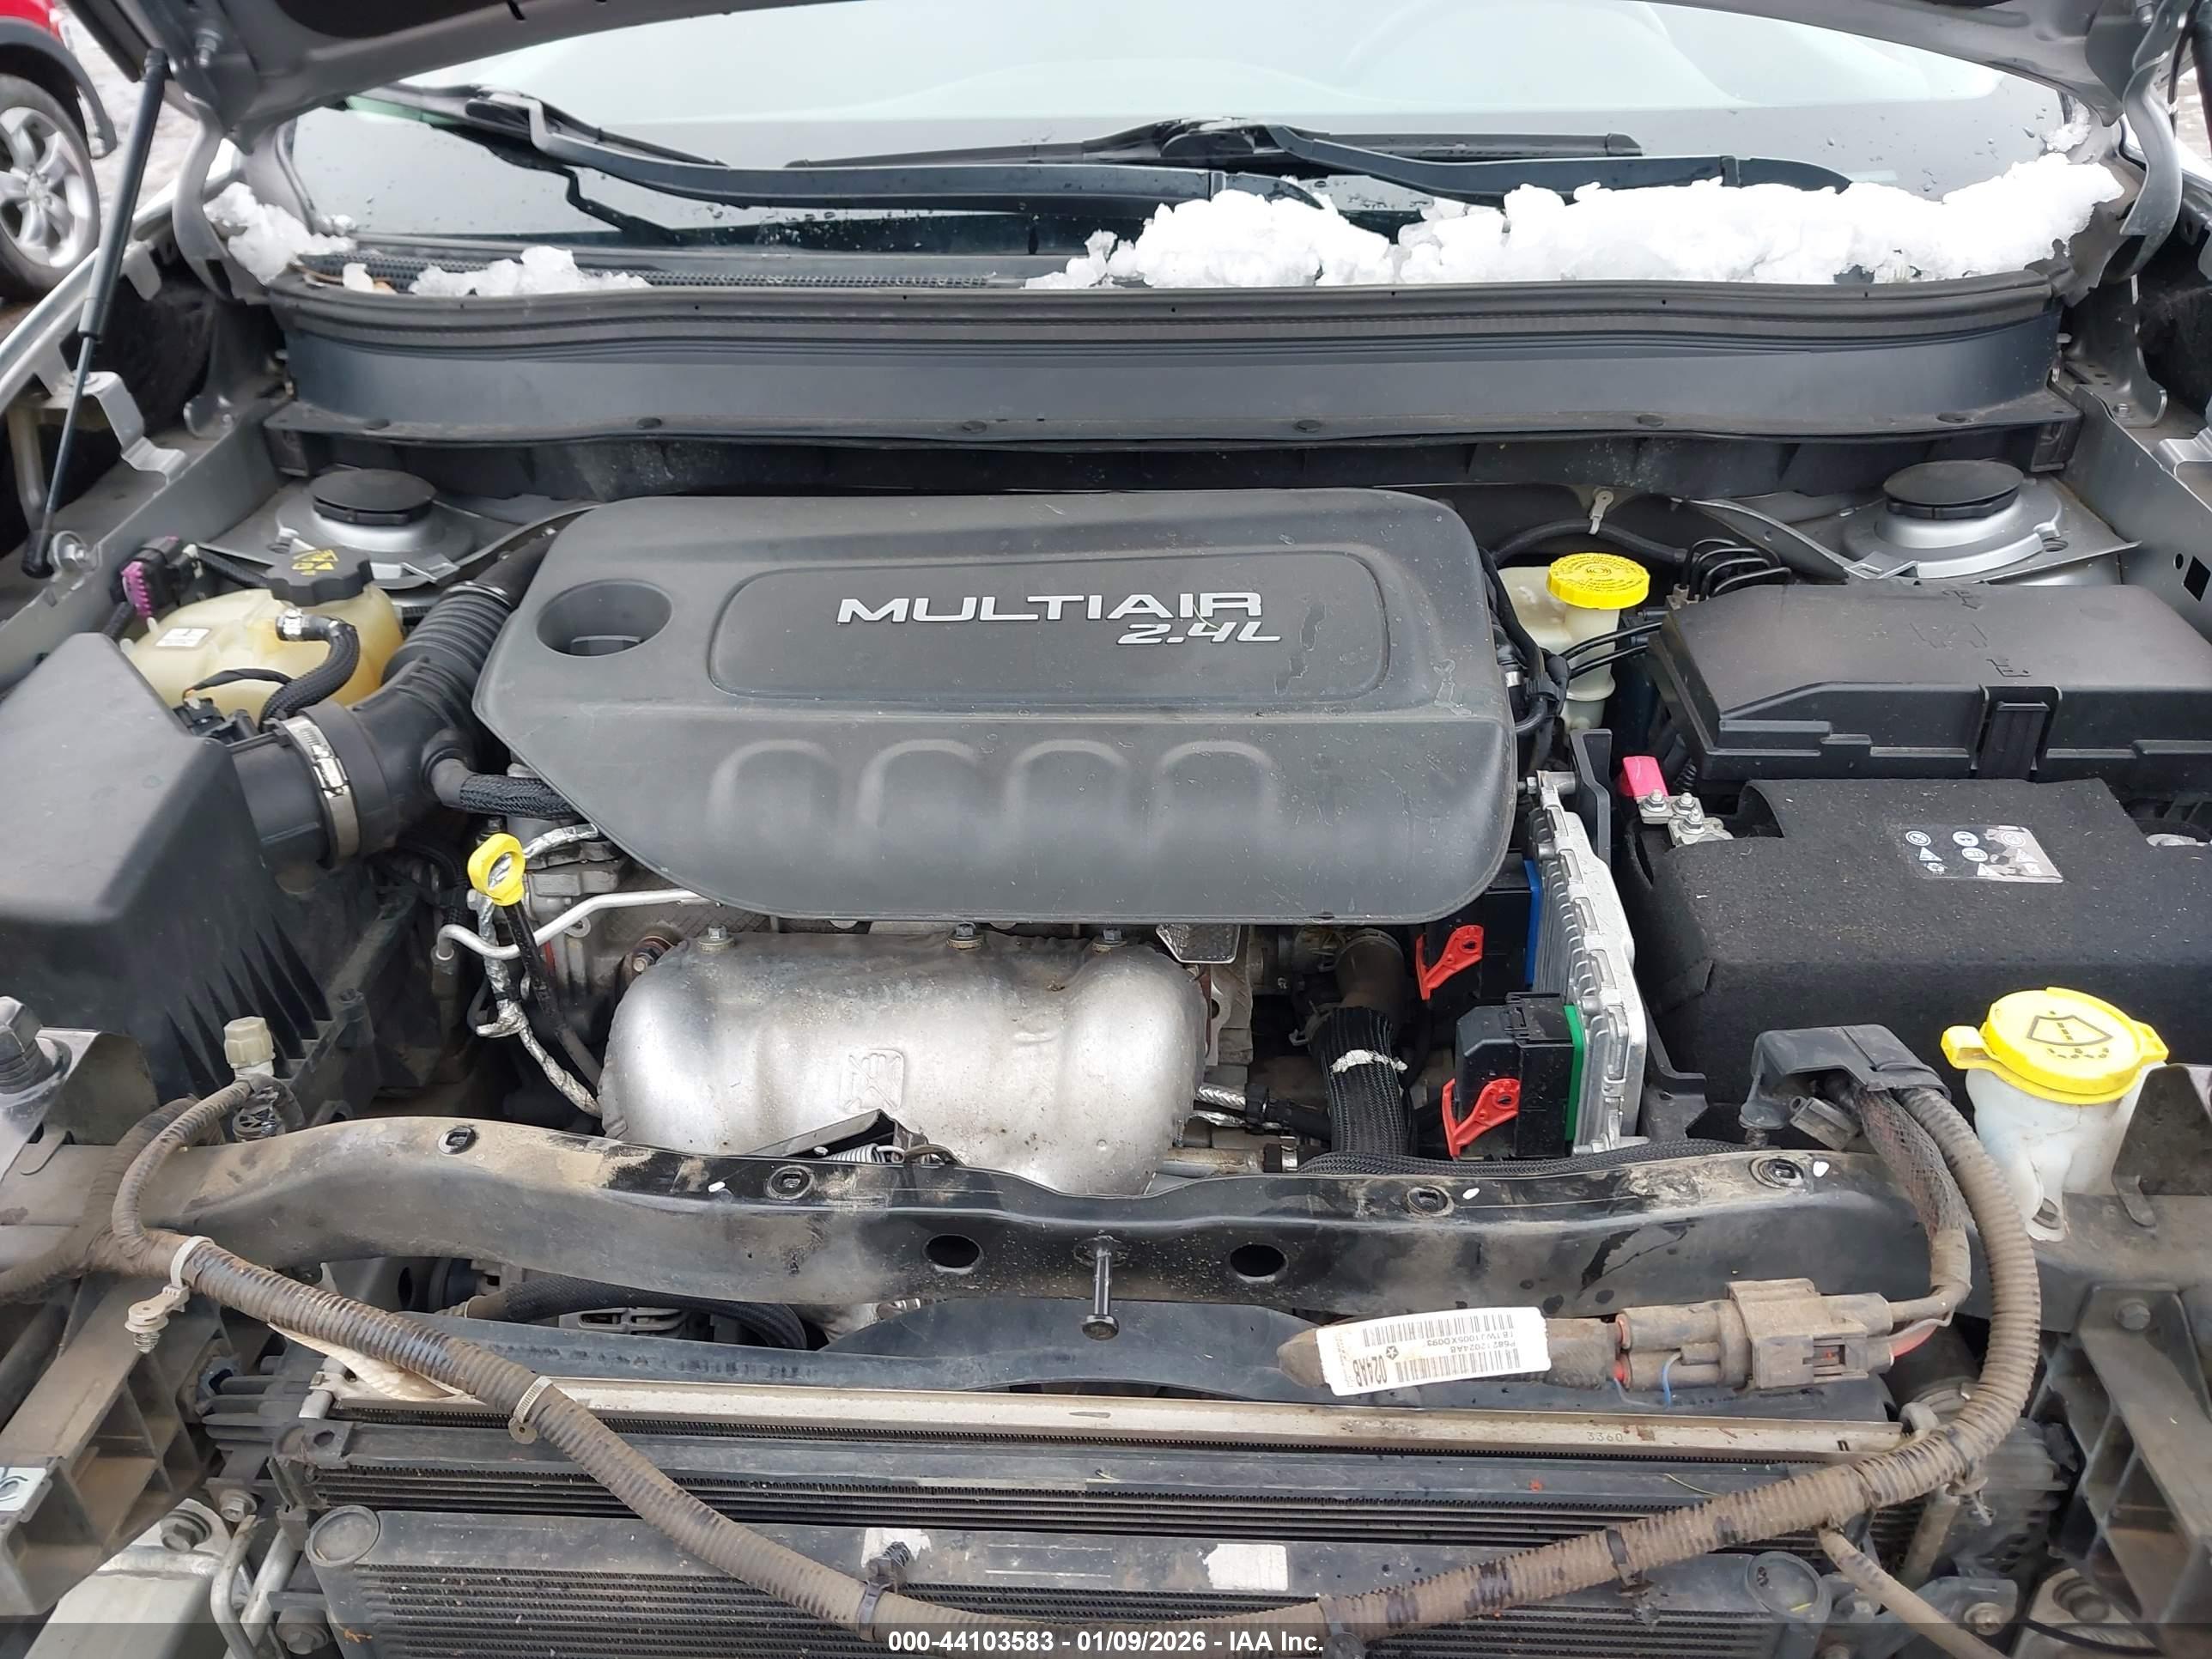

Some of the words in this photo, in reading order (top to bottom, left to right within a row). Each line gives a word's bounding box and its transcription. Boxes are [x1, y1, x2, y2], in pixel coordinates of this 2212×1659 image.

[836, 592, 1263, 624] MULTIAIR
[1116, 620, 1283, 646] 2.4L
[1352, 1354, 1388, 1388] 024AB
